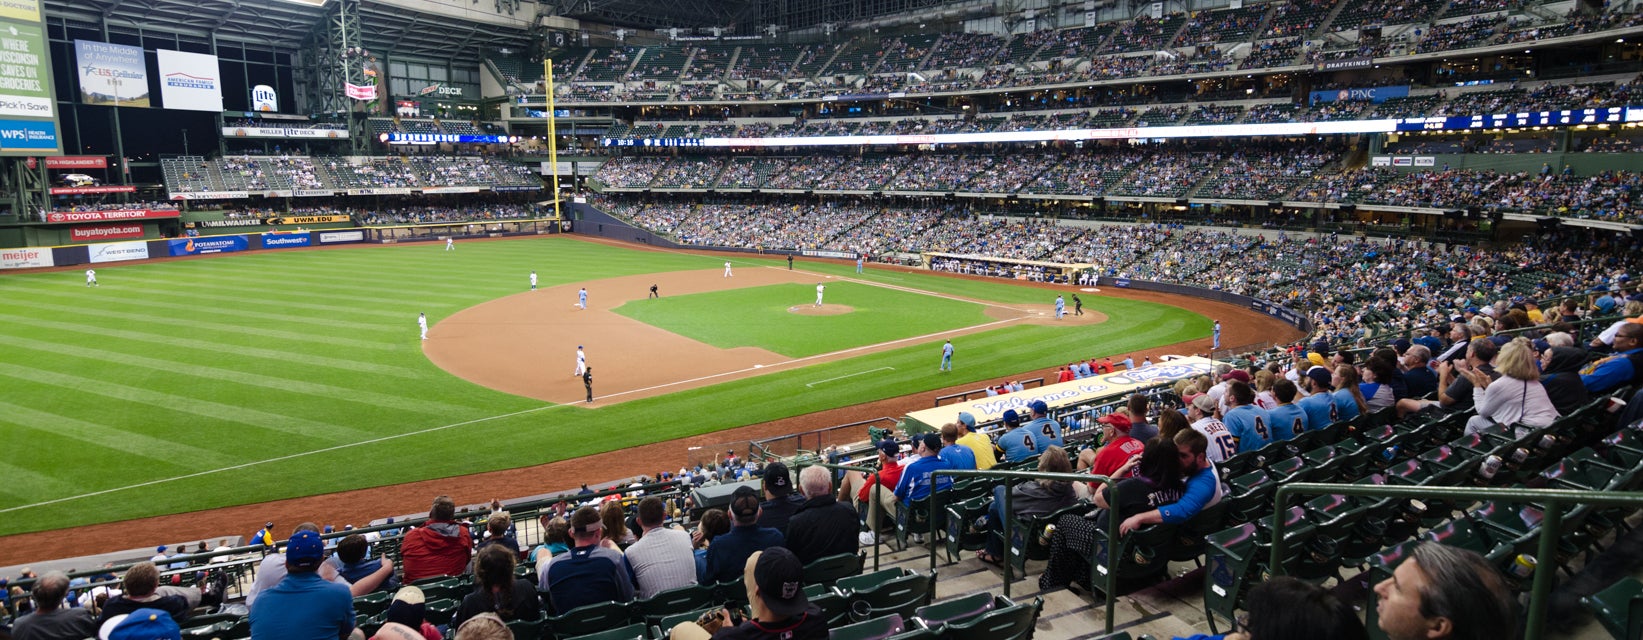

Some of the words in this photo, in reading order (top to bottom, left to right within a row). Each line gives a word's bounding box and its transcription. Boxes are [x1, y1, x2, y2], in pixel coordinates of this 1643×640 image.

[2, 38, 29, 52] WHERE
[82, 43, 89, 51] In
[91, 44, 107, 53] the
[109, 46, 138, 56] Middle
[84, 52, 93, 60] of
[95, 55, 138, 65] Anywhere
[1326, 60, 1370, 69] DRAFTKINGS
[0, 63, 26, 77] SAVES
[26, 67, 37, 78] ON
[112, 70, 143, 79] Cellular
[255, 90, 274, 102] Lite
[438, 86, 462, 96] DECK
[1351, 89, 1376, 99] PNC
[0, 101, 18, 109] Pick
[27, 103, 48, 112] Save
[1, 129, 25, 140] WPS
[65, 212, 101, 220] TOYOTA
[102, 210, 146, 219] TERRITORY
[74, 226, 141, 237] buyatoyota.com
[194, 240, 235, 248] POTAWATOMI
[266, 237, 302, 245] Southwest
[2, 250, 39, 261] meijer
[1078, 384, 1108, 393] to
[1042, 423, 1056, 440] 4
[1254, 415, 1269, 441] 4
[1292, 417, 1304, 435] 4
[1023, 435, 1035, 452] 4
[1214, 433, 1235, 461] 15
